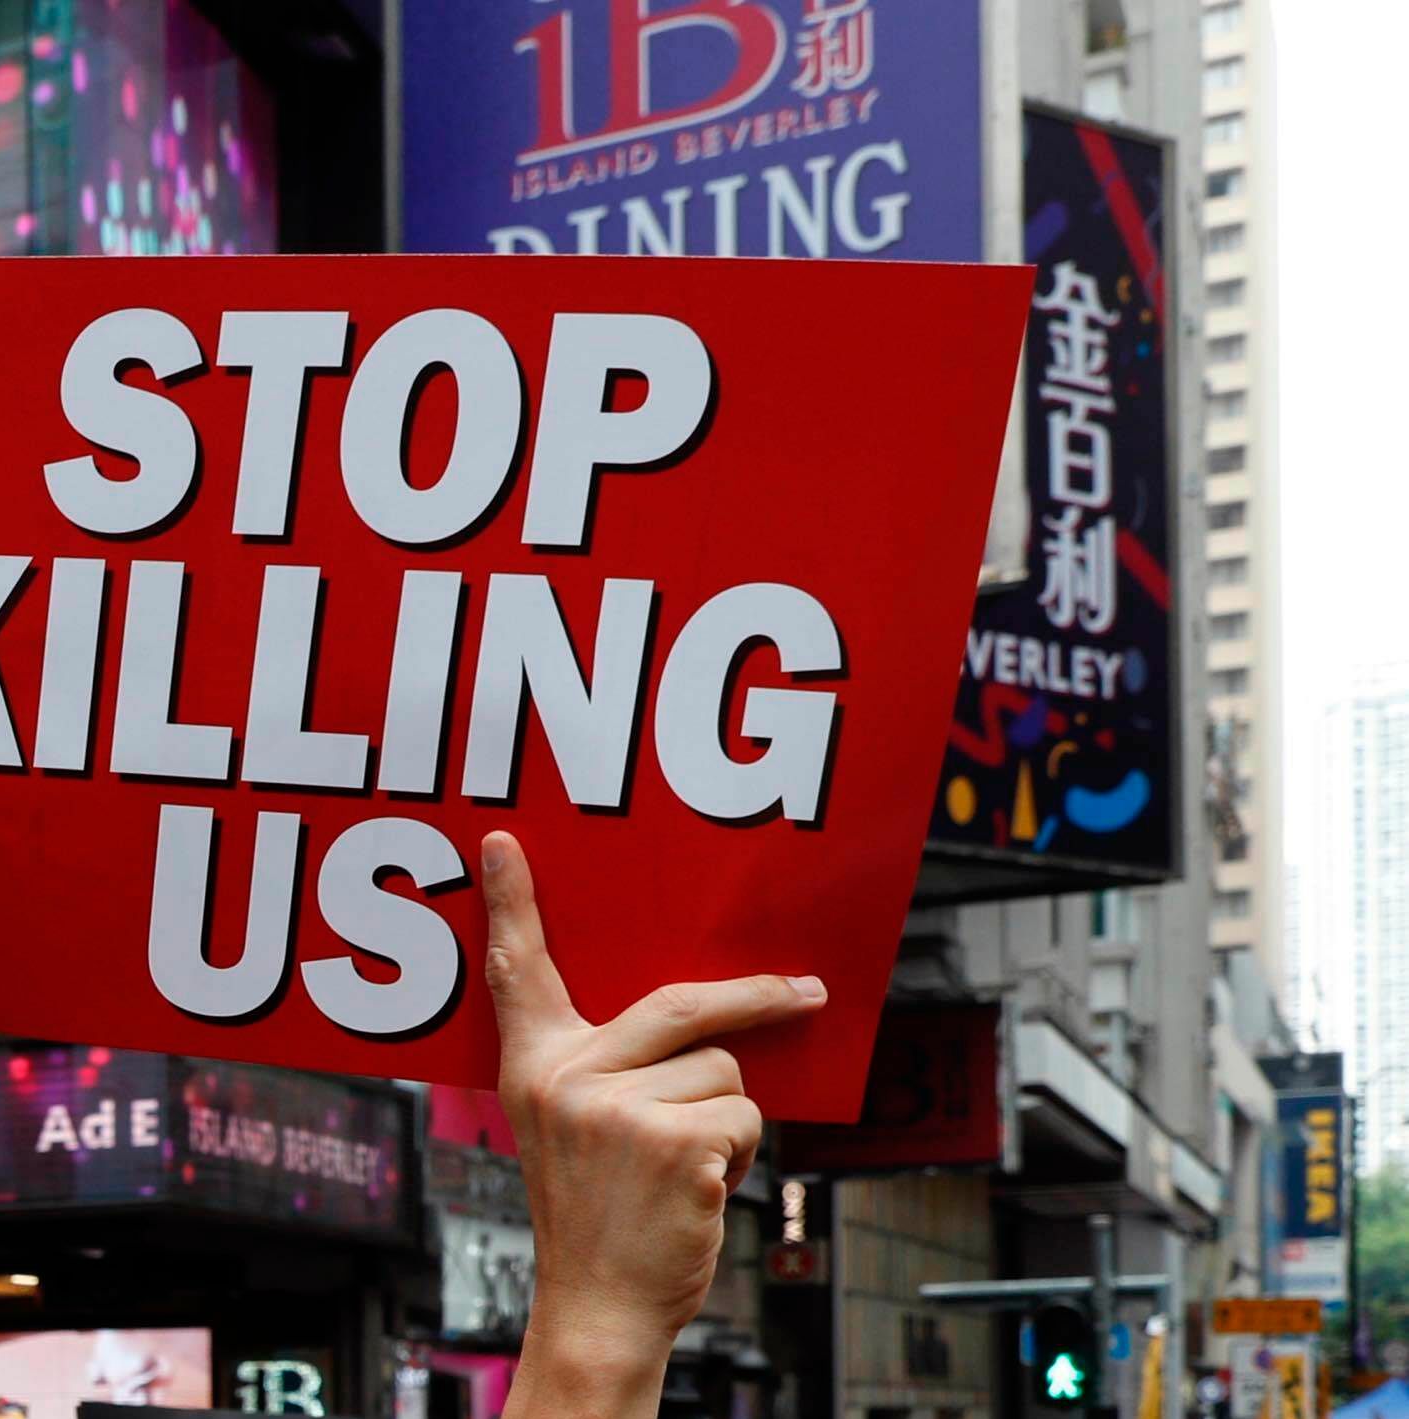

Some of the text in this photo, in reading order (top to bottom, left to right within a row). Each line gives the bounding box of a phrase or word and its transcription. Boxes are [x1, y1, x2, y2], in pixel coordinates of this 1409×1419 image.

[791, 0, 877, 98] 利
[487, 139, 912, 259] NING
[510, 88, 880, 203] ISLAND BEVERLEY
[43, 307, 715, 546] STOP
[1034, 261, 1120, 633] 金百利
[960, 625, 1126, 700] VERLEY
[148, 804, 466, 1034] US
[35, 1099, 117, 1154] Ad
[189, 1105, 381, 1186] ISLAND BEVERLEY
[1304, 1107, 1338, 1226] IKEA
